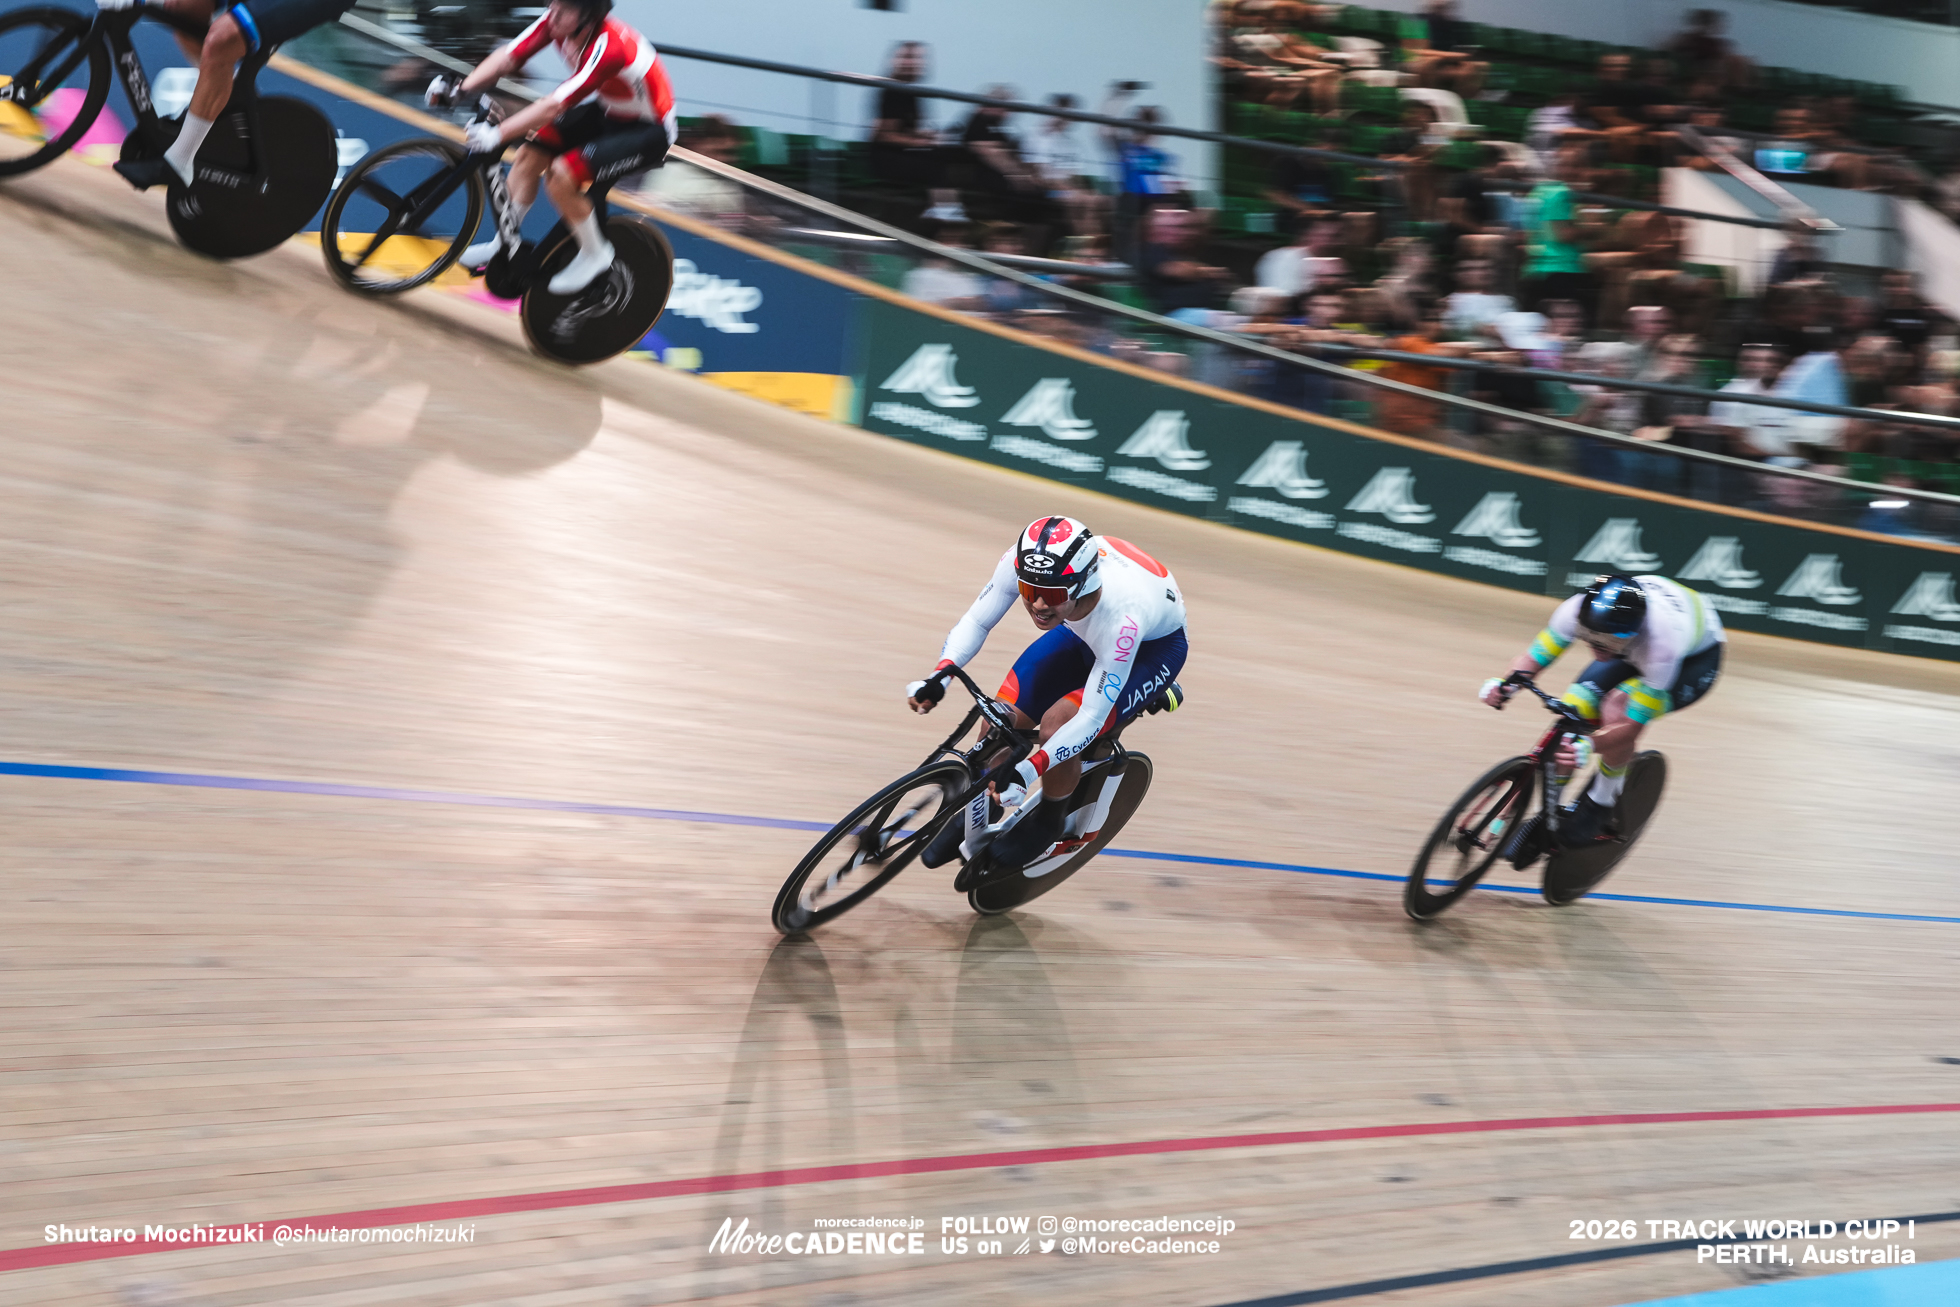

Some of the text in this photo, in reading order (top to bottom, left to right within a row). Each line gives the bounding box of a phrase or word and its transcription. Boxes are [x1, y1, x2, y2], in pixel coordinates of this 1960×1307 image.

[1023, 565, 1054, 575] Kabuto
[1096, 670, 1108, 695] KEIRIN
[1121, 663, 1171, 715] JAPAN
[1072, 727, 1100, 754] Cyclers
[971, 791, 986, 831] TORAY
